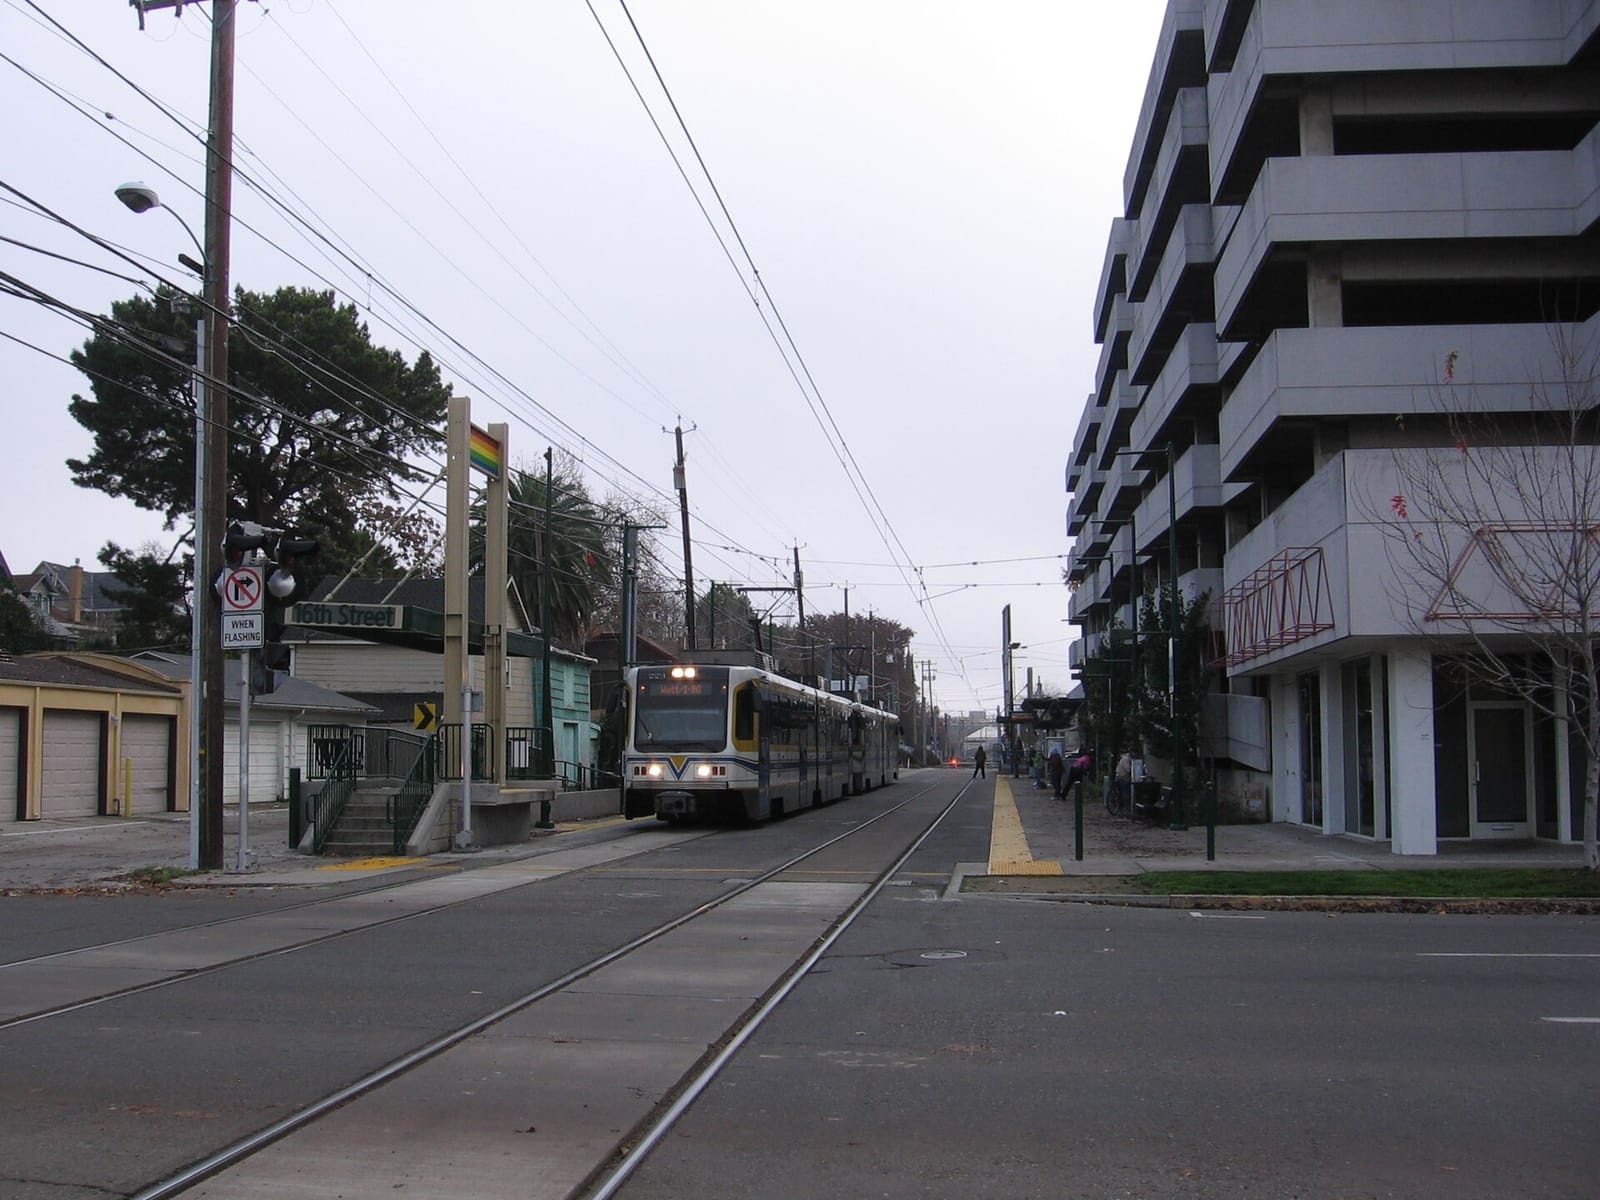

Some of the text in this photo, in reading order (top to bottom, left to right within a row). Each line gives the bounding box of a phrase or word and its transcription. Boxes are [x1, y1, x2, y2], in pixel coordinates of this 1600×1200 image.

[295, 603, 394, 626] 16th Street
[231, 619, 254, 629] WHEN
[224, 631, 261, 642] FLASHING
